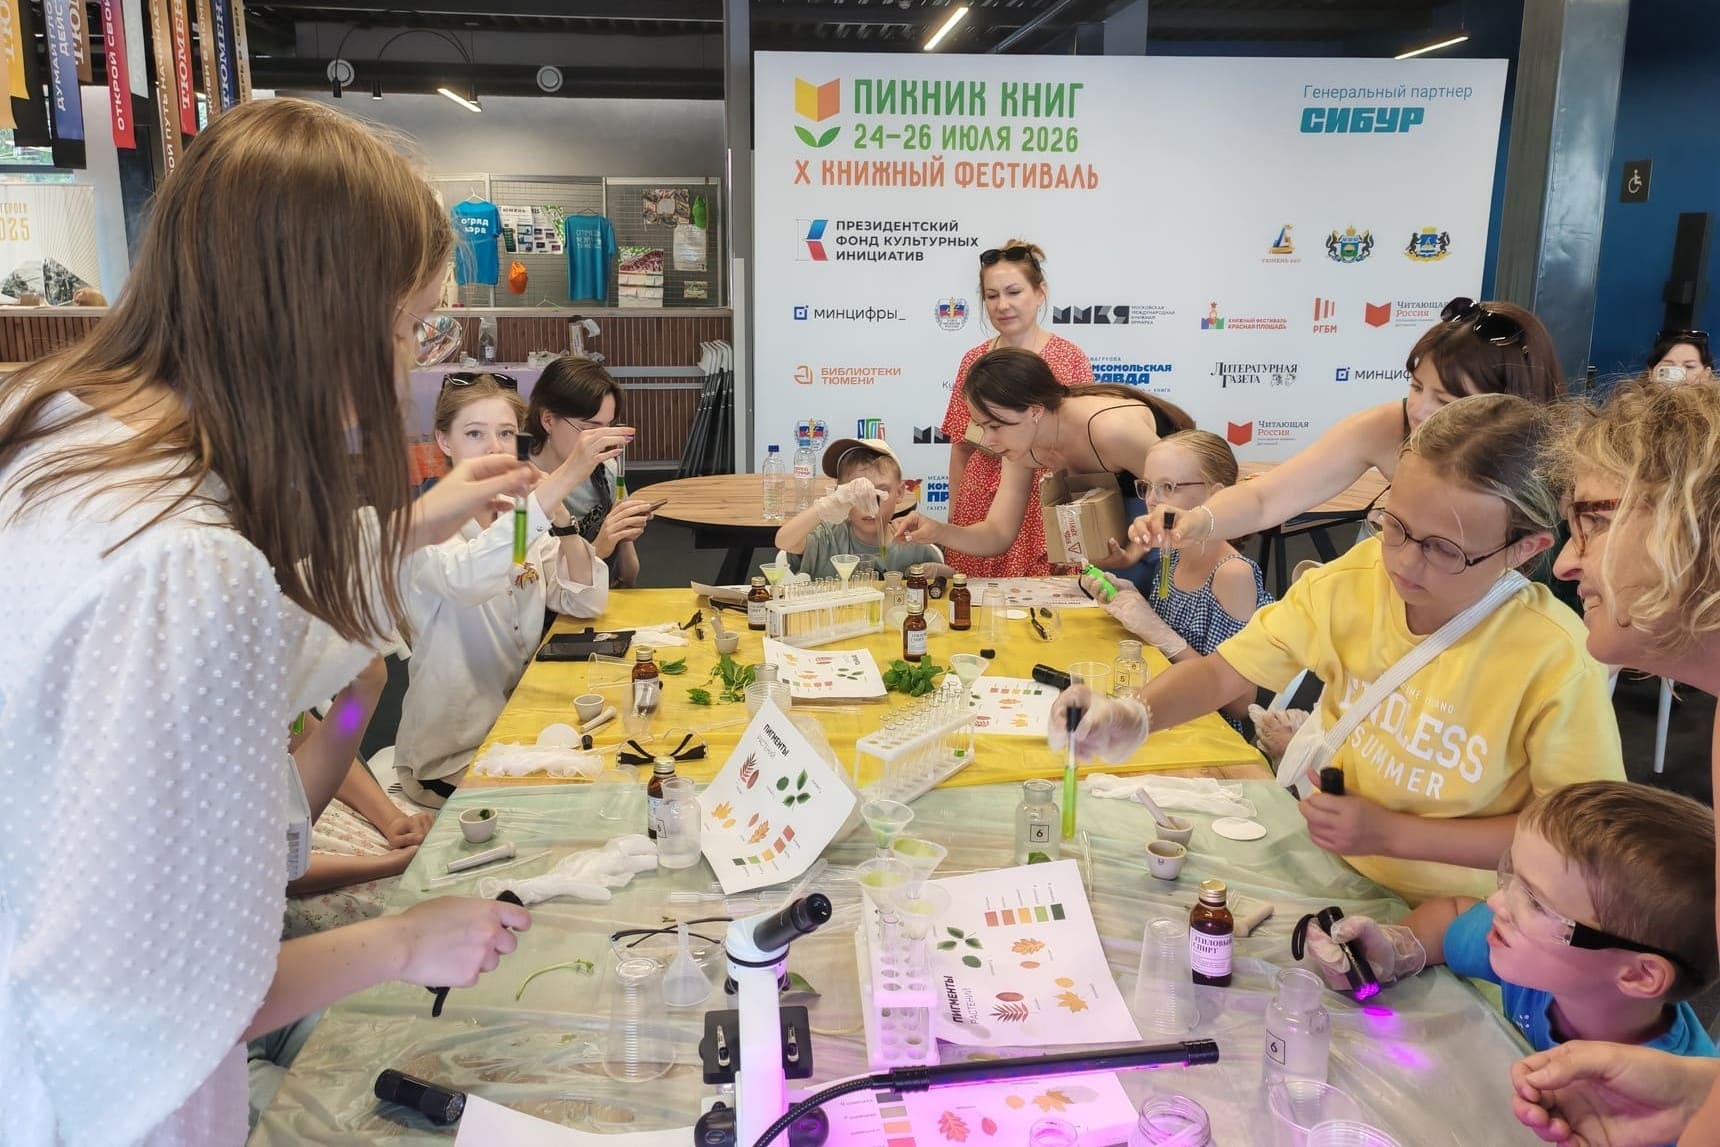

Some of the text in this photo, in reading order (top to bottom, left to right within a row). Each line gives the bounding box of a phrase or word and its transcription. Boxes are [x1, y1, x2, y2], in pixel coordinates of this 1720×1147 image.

[152, 0, 167, 89] НАЧИНАЕ
[50, 44, 66, 111] ДУМАЙ
[108, 51, 125, 131] ОТКРОЙ
[854, 79, 1084, 118] ПИКНИК КНИГ
[1303, 85, 1473, 101] Генеральный партнер
[162, 94, 173, 140] ПУТЬ
[1300, 107, 1425, 133] СИБУР
[942, 125, 1011, 151] ИЮЛЯ
[1022, 126, 1079, 153] 2026
[822, 155, 945, 187] КНИЖНЫЙ
[954, 160, 1099, 189] ФЕСТИВАЛЬ
[463, 227, 487, 235] эра
[836, 219, 959, 233] ПРЕЗИДЕНТСКИЙ
[836, 235, 979, 248] ФОНД КУЛЬТУРНЫХ
[836, 251, 924, 263] ИНИЦИАТИВ
[1313, 325, 1337, 333] РГБМ
[821, 367, 902, 376] БИБЛИОТЕКИ
[1091, 364, 1172, 372] МСОМОЛЬСКАЯ
[821, 376, 875, 385] ТЮМЕНИ
[1093, 373, 1150, 386] РАВДА
[762, 723, 790, 757] ПИГМЕНТЫ
[1351, 725, 1445, 800] SUMMER
[1036, 829, 1043, 838] 6
[943, 975, 964, 1024] ПИГМЕНТЫ
[1270, 1041, 1278, 1053] 6
